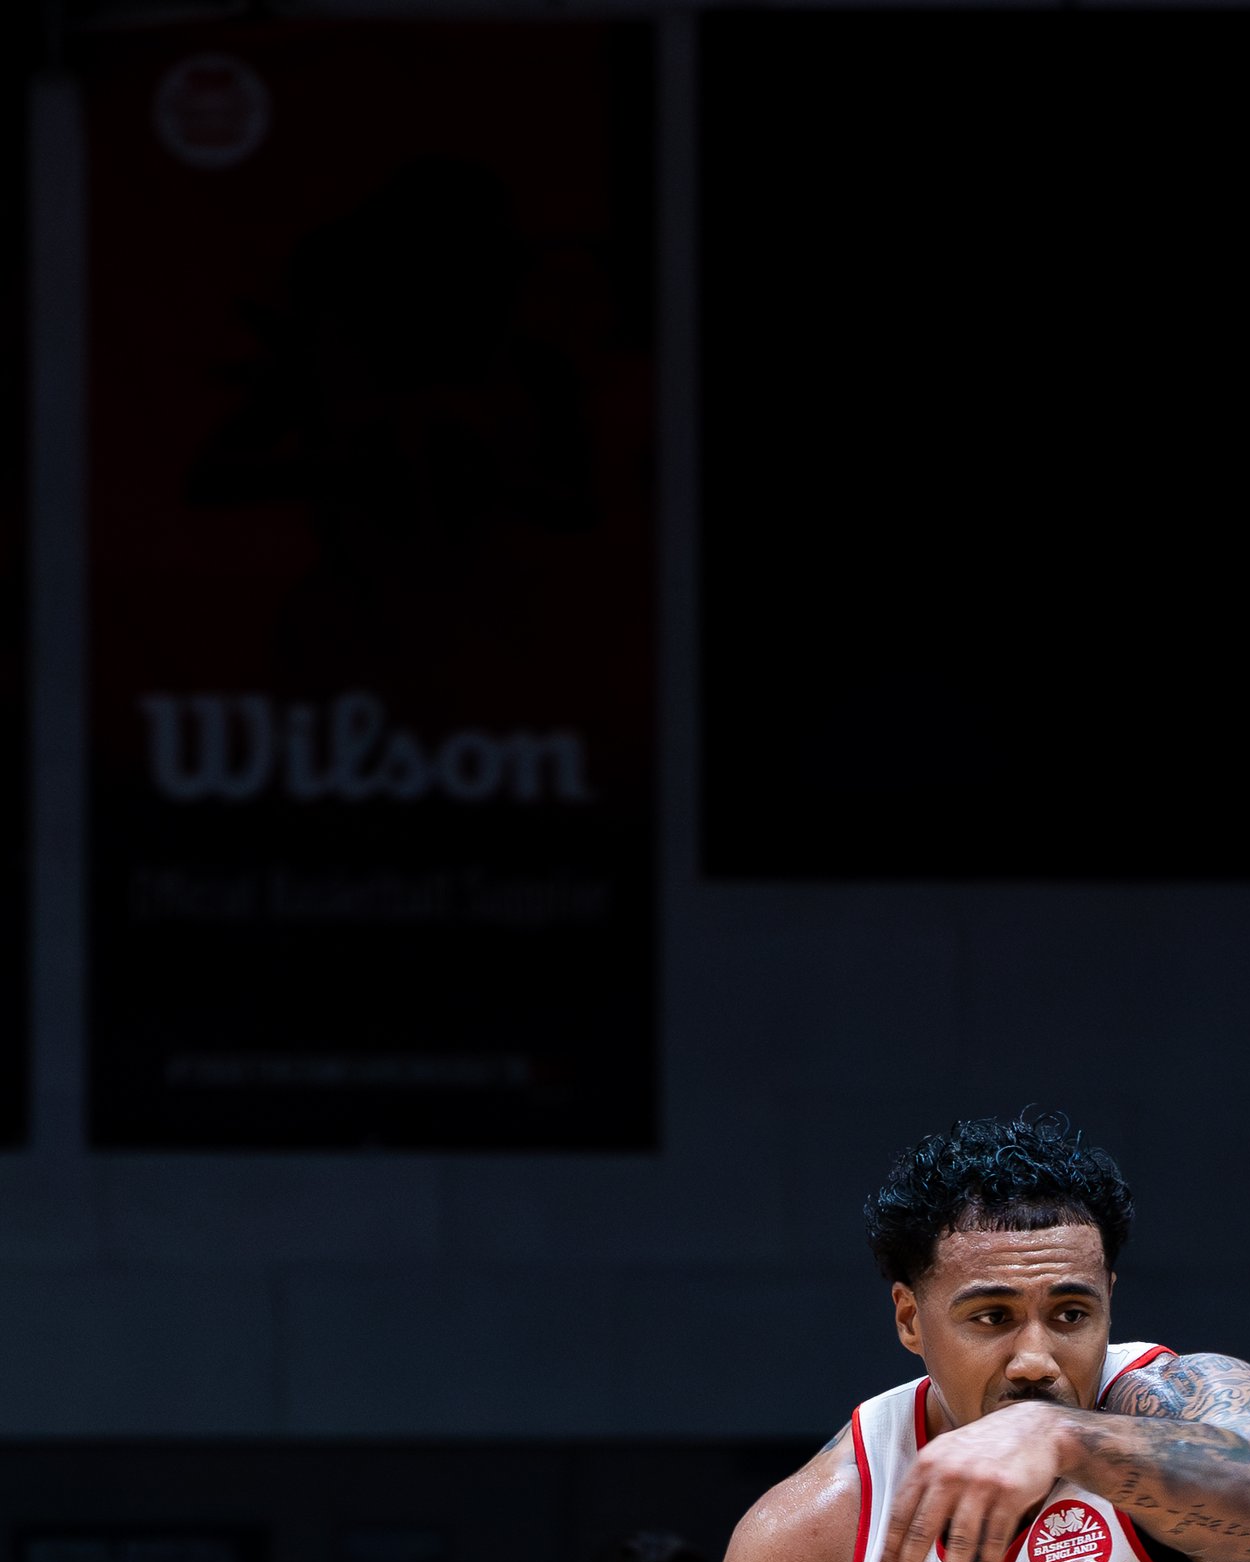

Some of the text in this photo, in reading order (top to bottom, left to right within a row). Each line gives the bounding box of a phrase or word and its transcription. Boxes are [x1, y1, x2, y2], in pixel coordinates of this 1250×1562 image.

[137, 688, 598, 803] Wilson
[1034, 1530, 1106, 1556] BASKETBALL
[1045, 1542, 1098, 1562] ENGLAND
